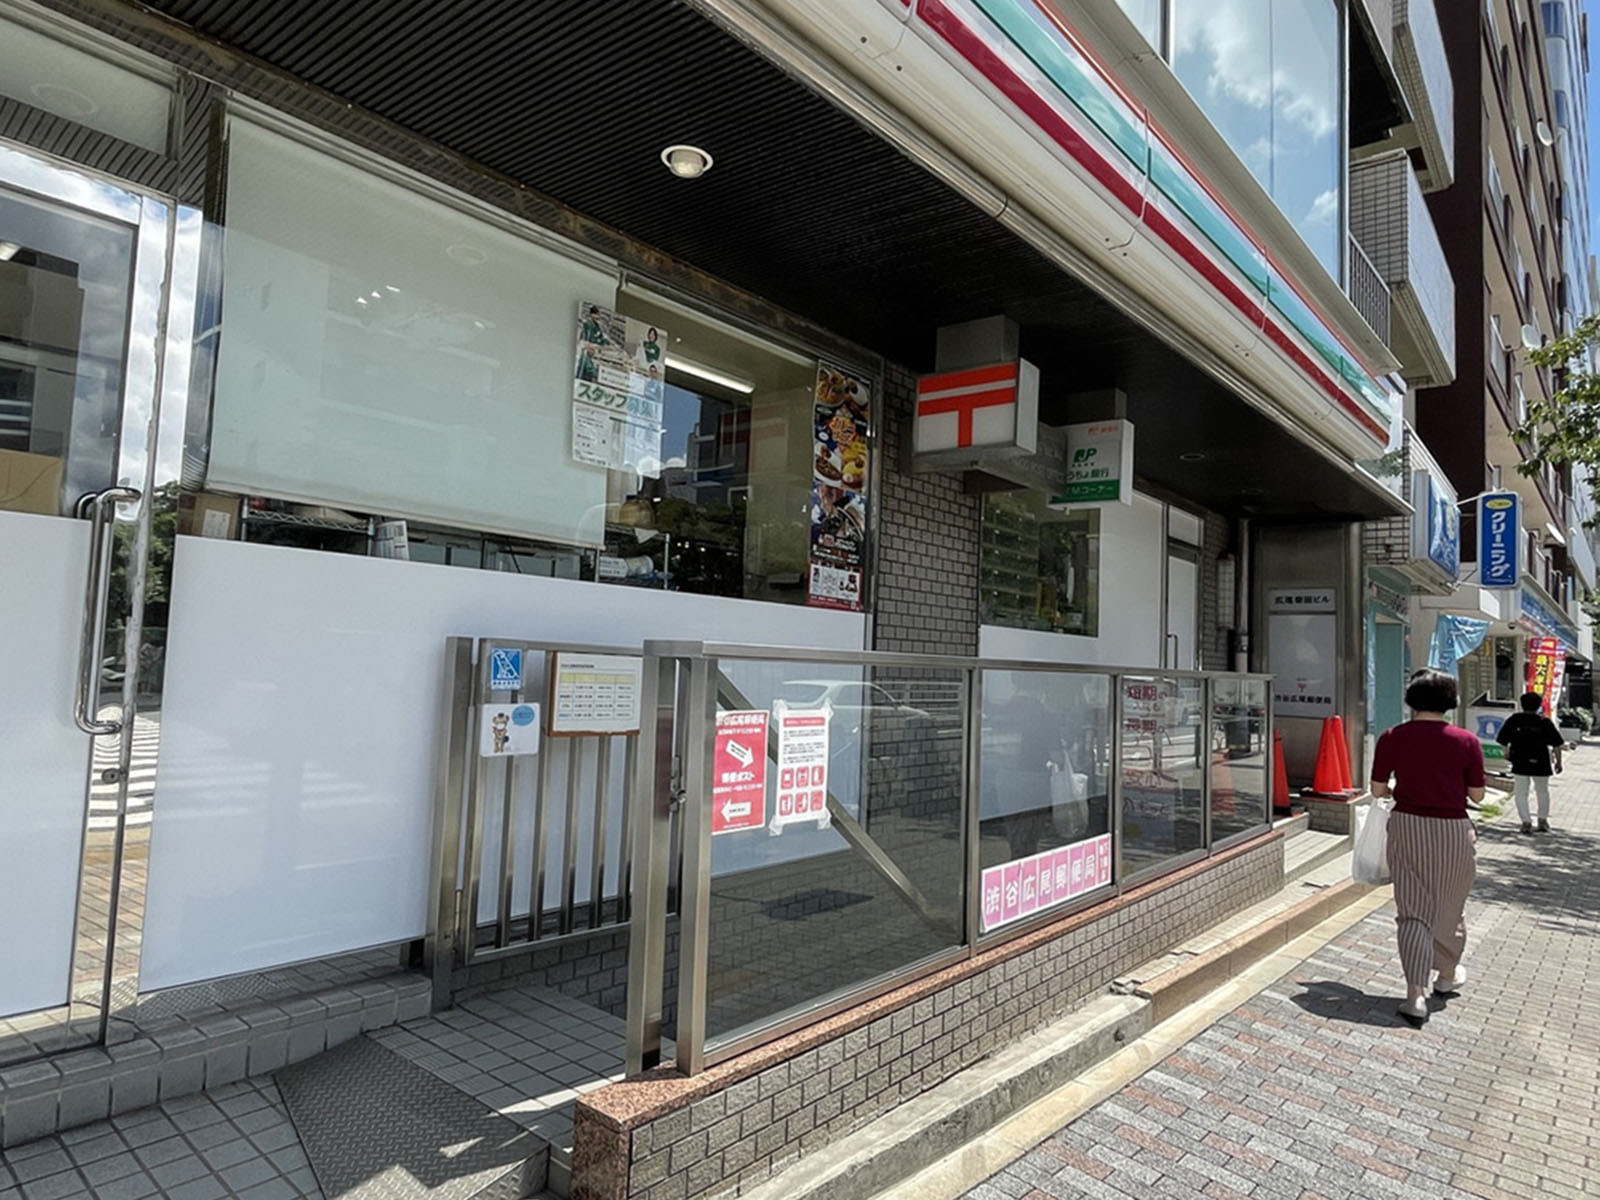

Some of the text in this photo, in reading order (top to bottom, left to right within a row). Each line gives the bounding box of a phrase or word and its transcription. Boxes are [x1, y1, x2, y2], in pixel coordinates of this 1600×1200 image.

[1066, 469, 1109, 480] うちょ銀行
[1490, 510, 1510, 577] クリーニング
[986, 854, 1096, 914] 渋谷広尾郵便局
